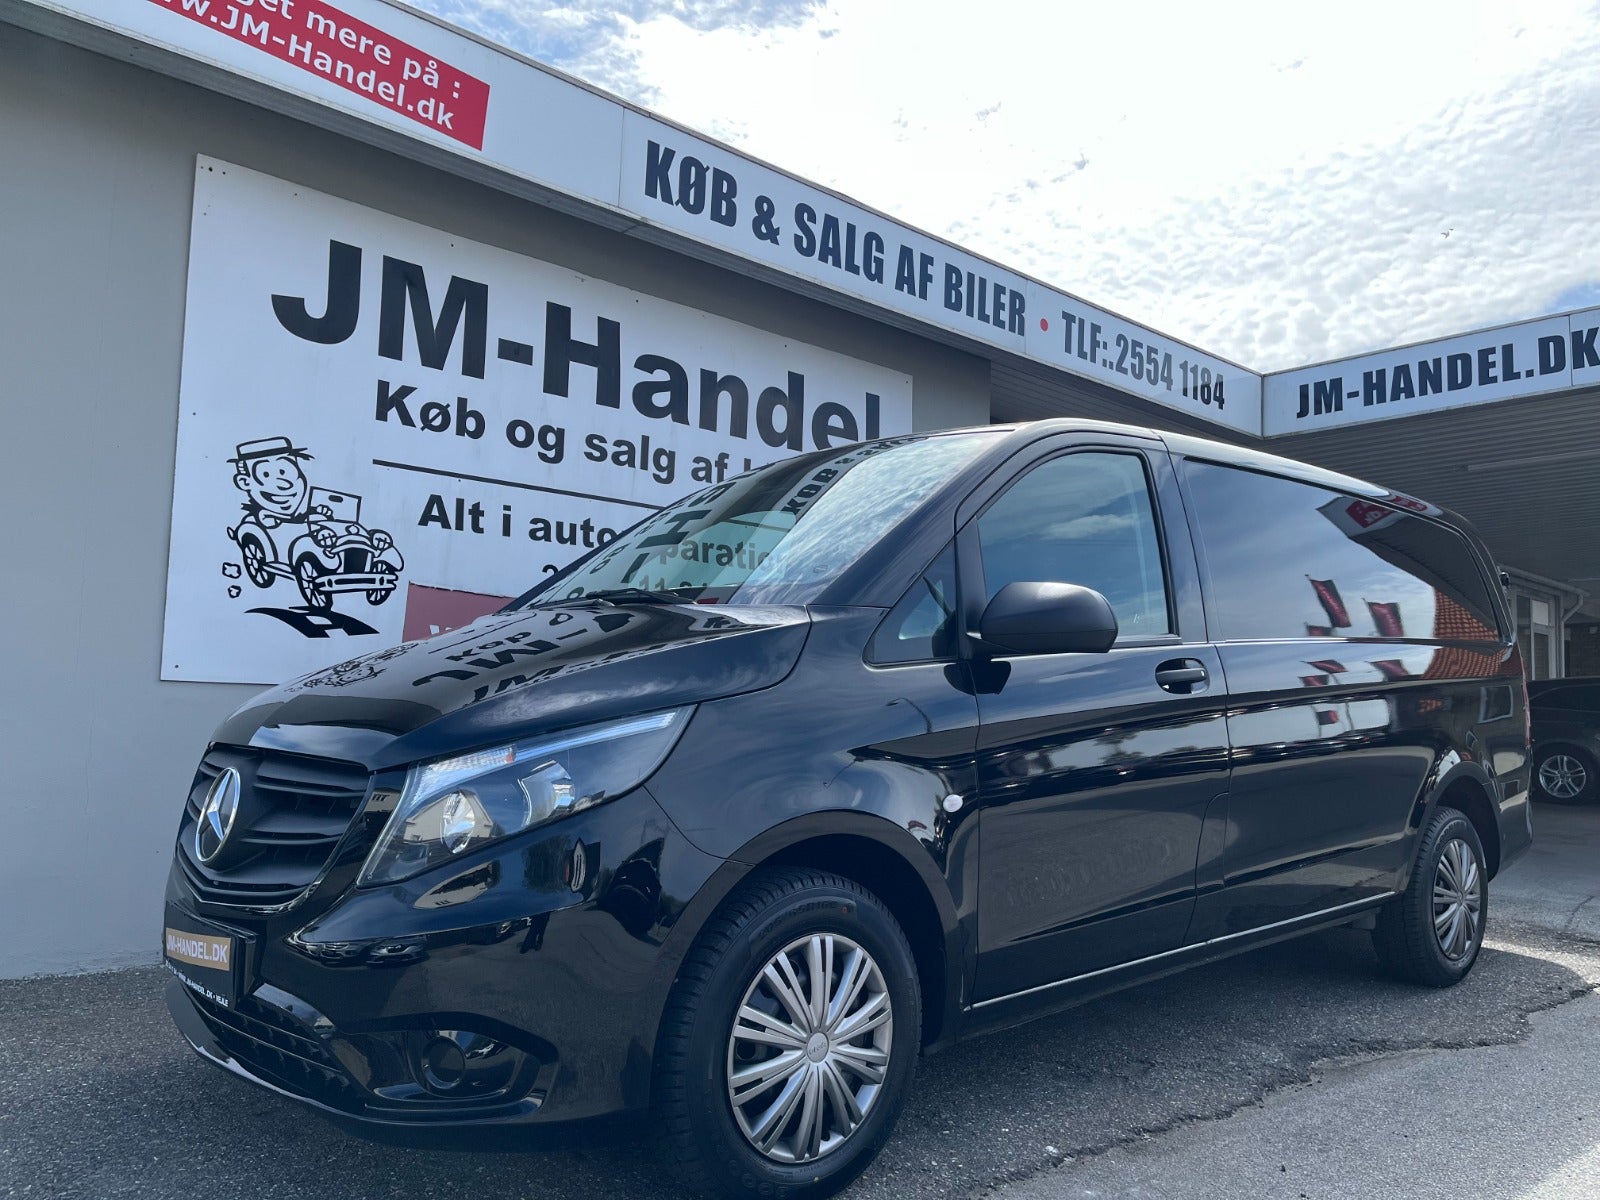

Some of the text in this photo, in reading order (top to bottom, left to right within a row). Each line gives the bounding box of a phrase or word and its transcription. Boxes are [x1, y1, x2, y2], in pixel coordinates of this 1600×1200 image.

[306, 11, 392, 66] mere
[403, 60, 440, 89] på
[645, 139, 737, 227] KØB
[752, 194, 780, 246] &
[793, 203, 885, 284] SALG
[895, 245, 934, 301] AF
[944, 263, 1026, 337] BILER
[1179, 360, 1225, 410] 1184
[271, 239, 880, 452] JM-Handel
[1296, 326, 1600, 419] JM-HANDEL.DK
[375, 379, 729, 485] Køb og salg af
[418, 494, 485, 535] Alt
[502, 504, 512, 537] i
[166, 934, 228, 964] JM-HANDEL.DK
